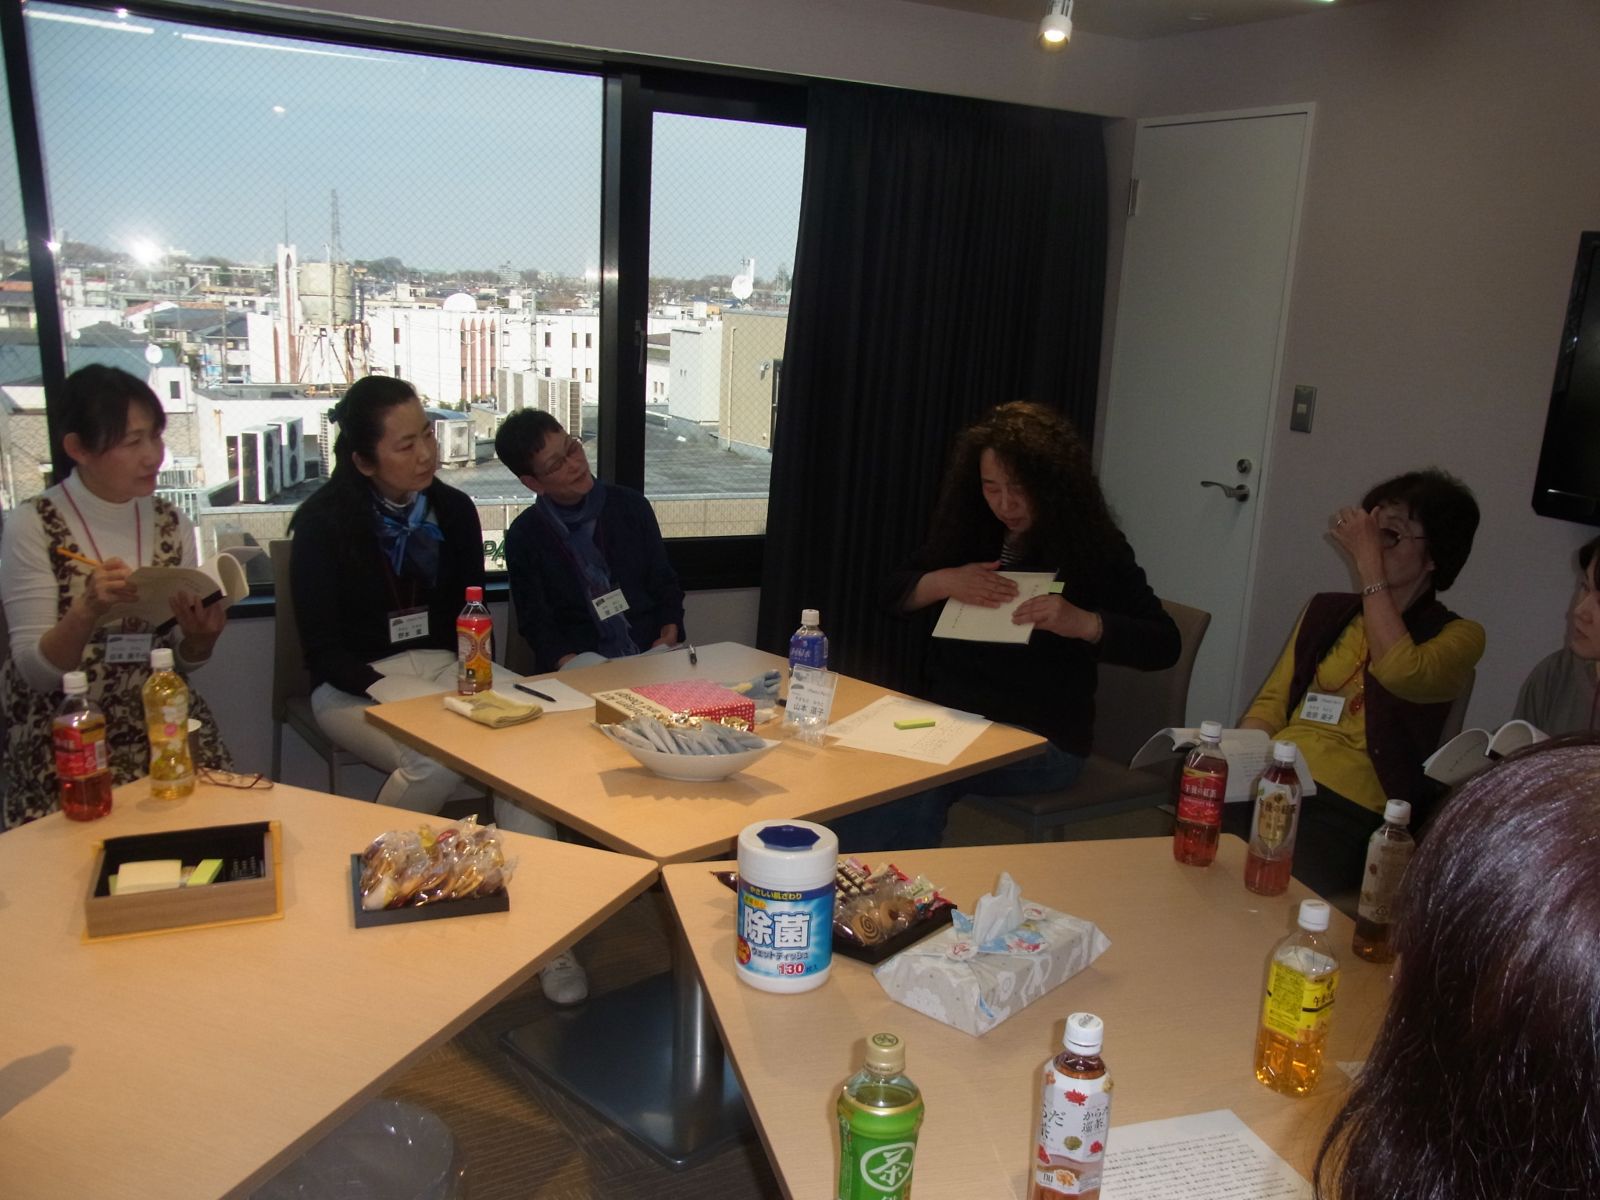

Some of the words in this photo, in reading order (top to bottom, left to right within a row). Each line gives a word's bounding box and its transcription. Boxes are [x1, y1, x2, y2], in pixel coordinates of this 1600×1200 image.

[743, 905, 811, 949] 除菌
[777, 962, 805, 975] 130
[869, 1148, 910, 1186] 茶
